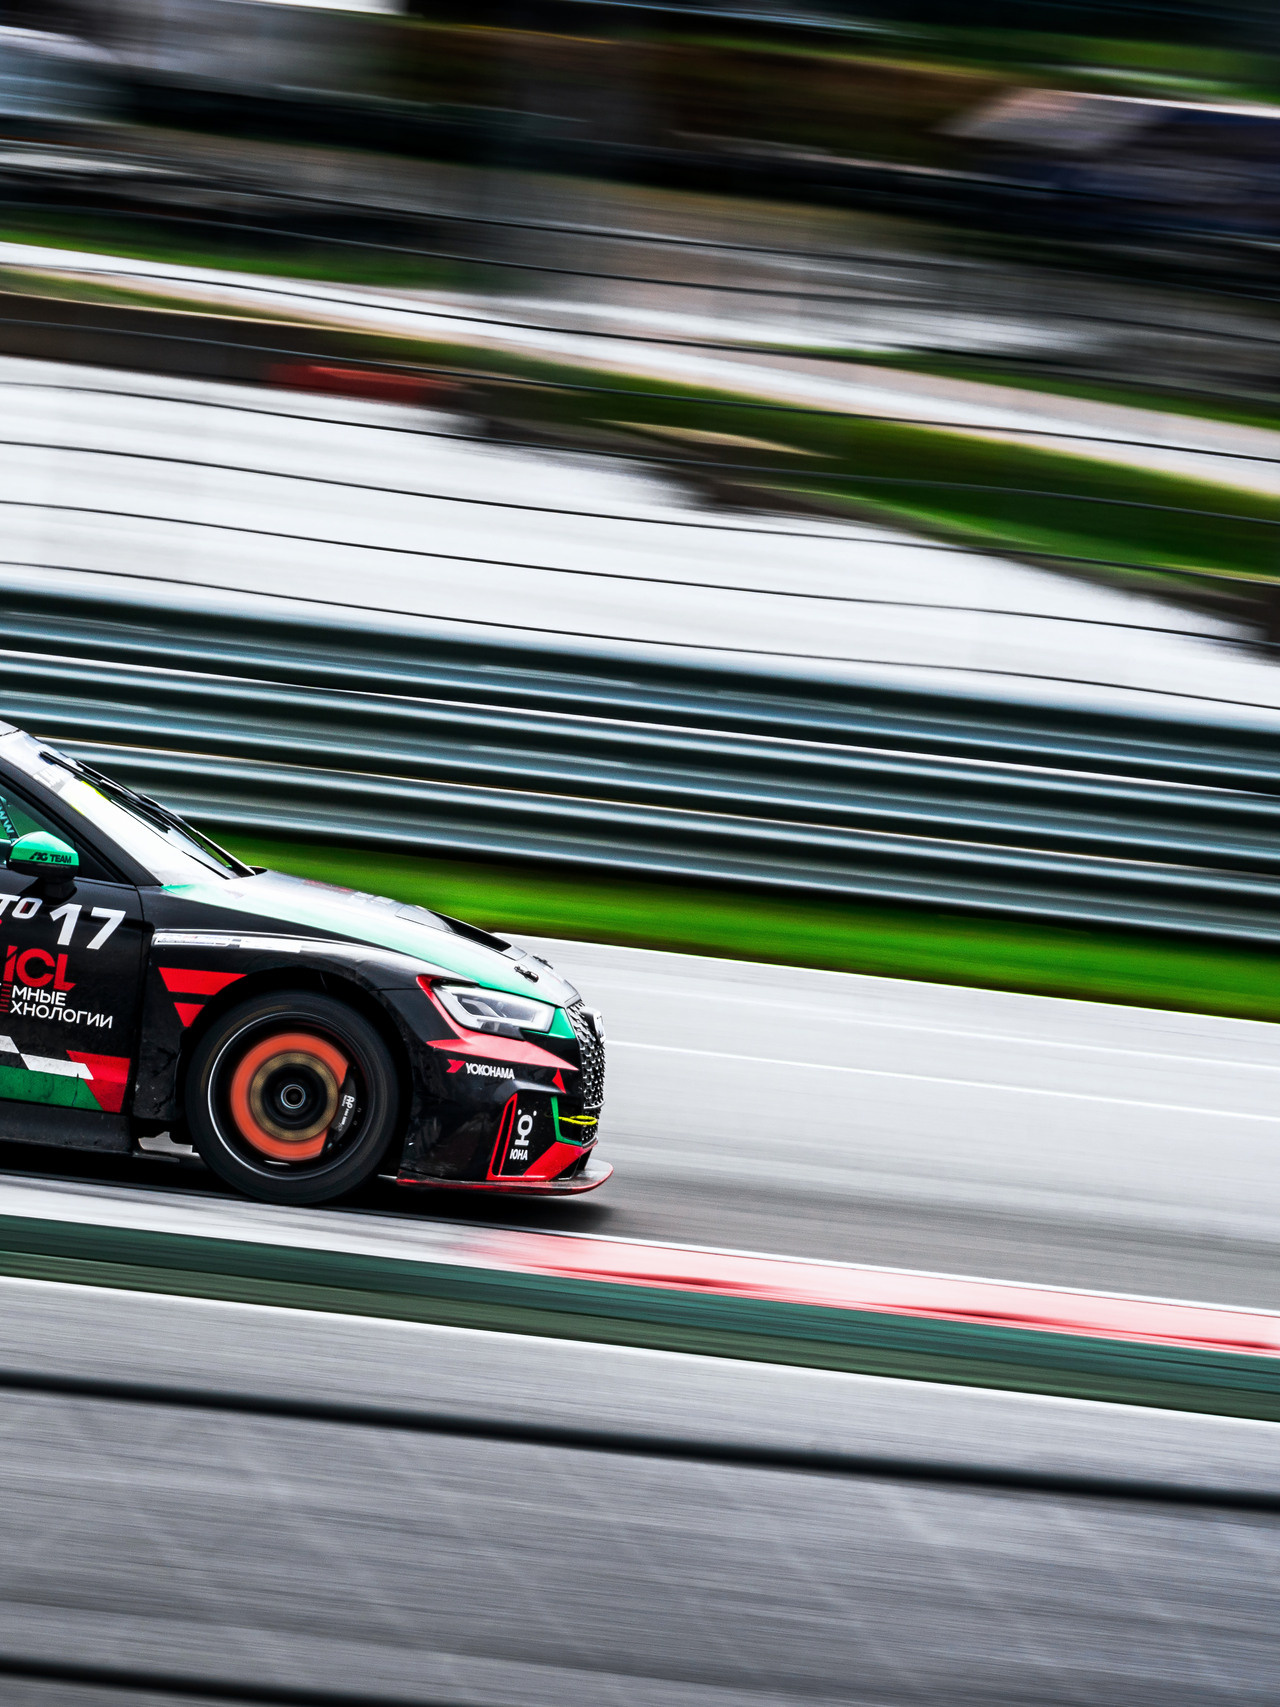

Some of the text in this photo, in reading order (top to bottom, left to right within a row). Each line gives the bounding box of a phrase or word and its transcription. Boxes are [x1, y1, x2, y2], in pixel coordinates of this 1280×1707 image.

[50, 853, 72, 864] TEAM
[49, 903, 127, 951] 17
[2, 945, 77, 991] ICL
[465, 1062, 516, 1080] YOKOHAMA
[509, 1148, 528, 1161] ЮНА
